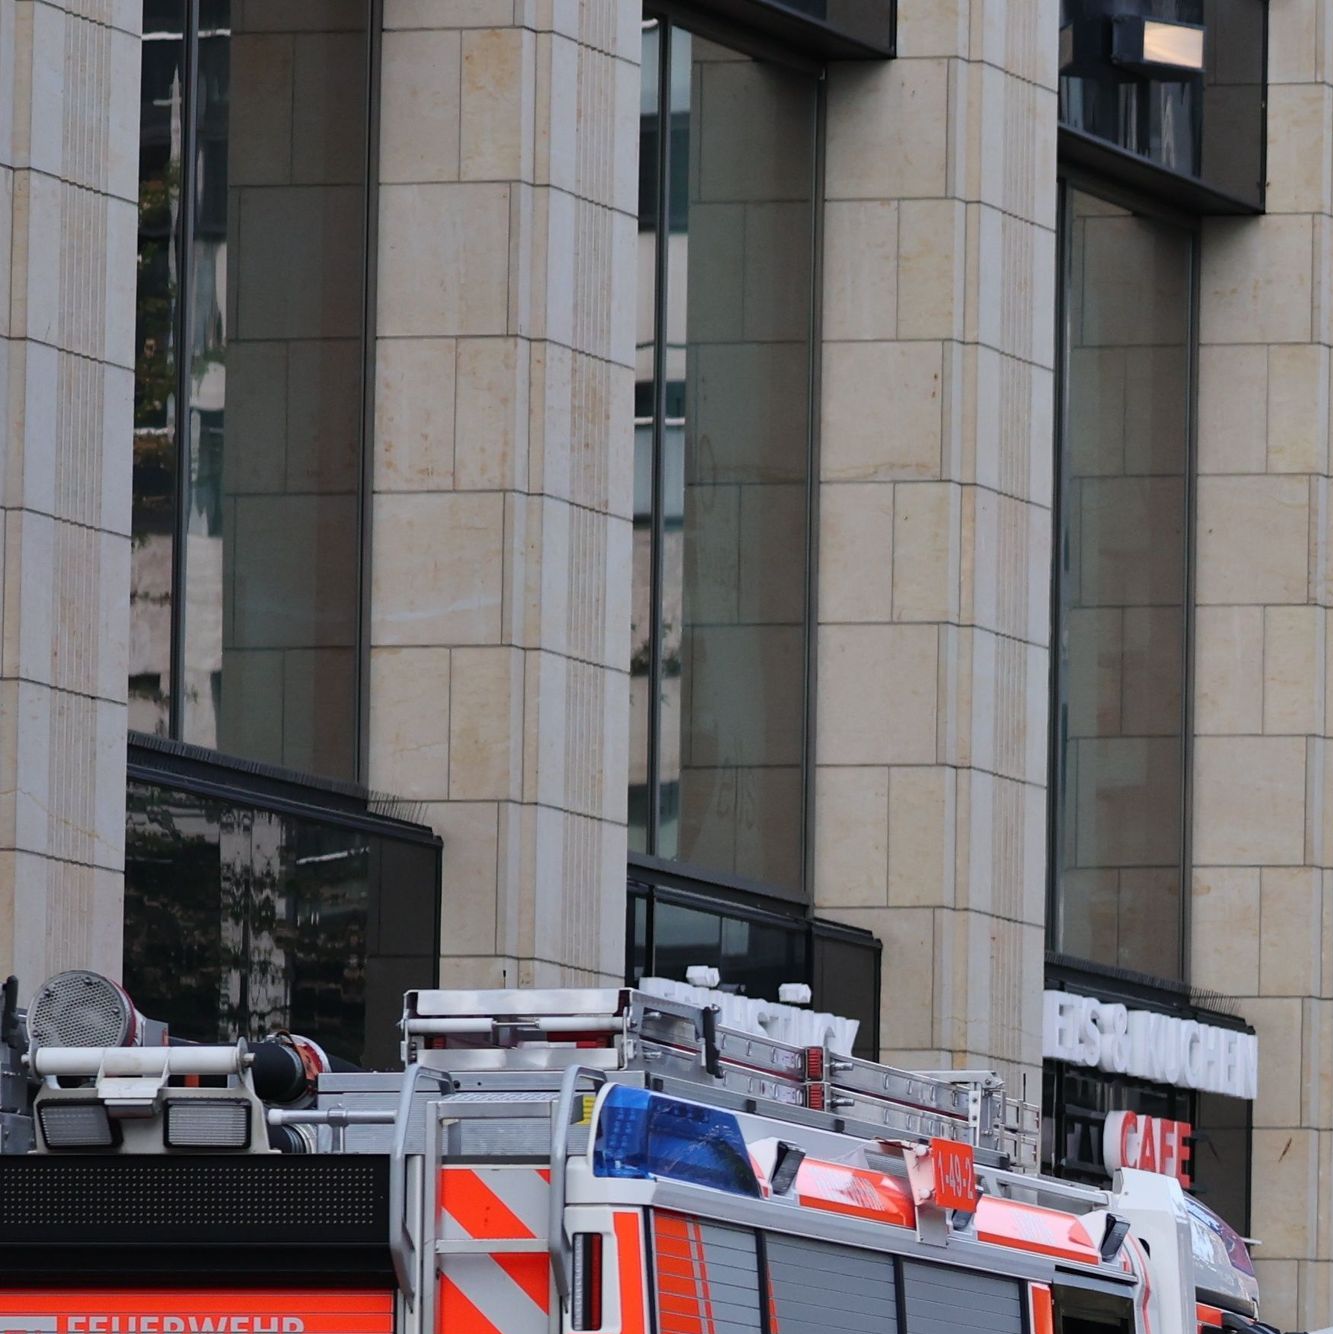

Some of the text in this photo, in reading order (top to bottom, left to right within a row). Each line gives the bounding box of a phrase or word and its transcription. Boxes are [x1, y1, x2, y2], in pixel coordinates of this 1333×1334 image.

[1043, 989, 1258, 1099] EIS & KUCHEN
[936, 1152, 974, 1201] 1-49-2
[1119, 1110, 1192, 1189] CAFE
